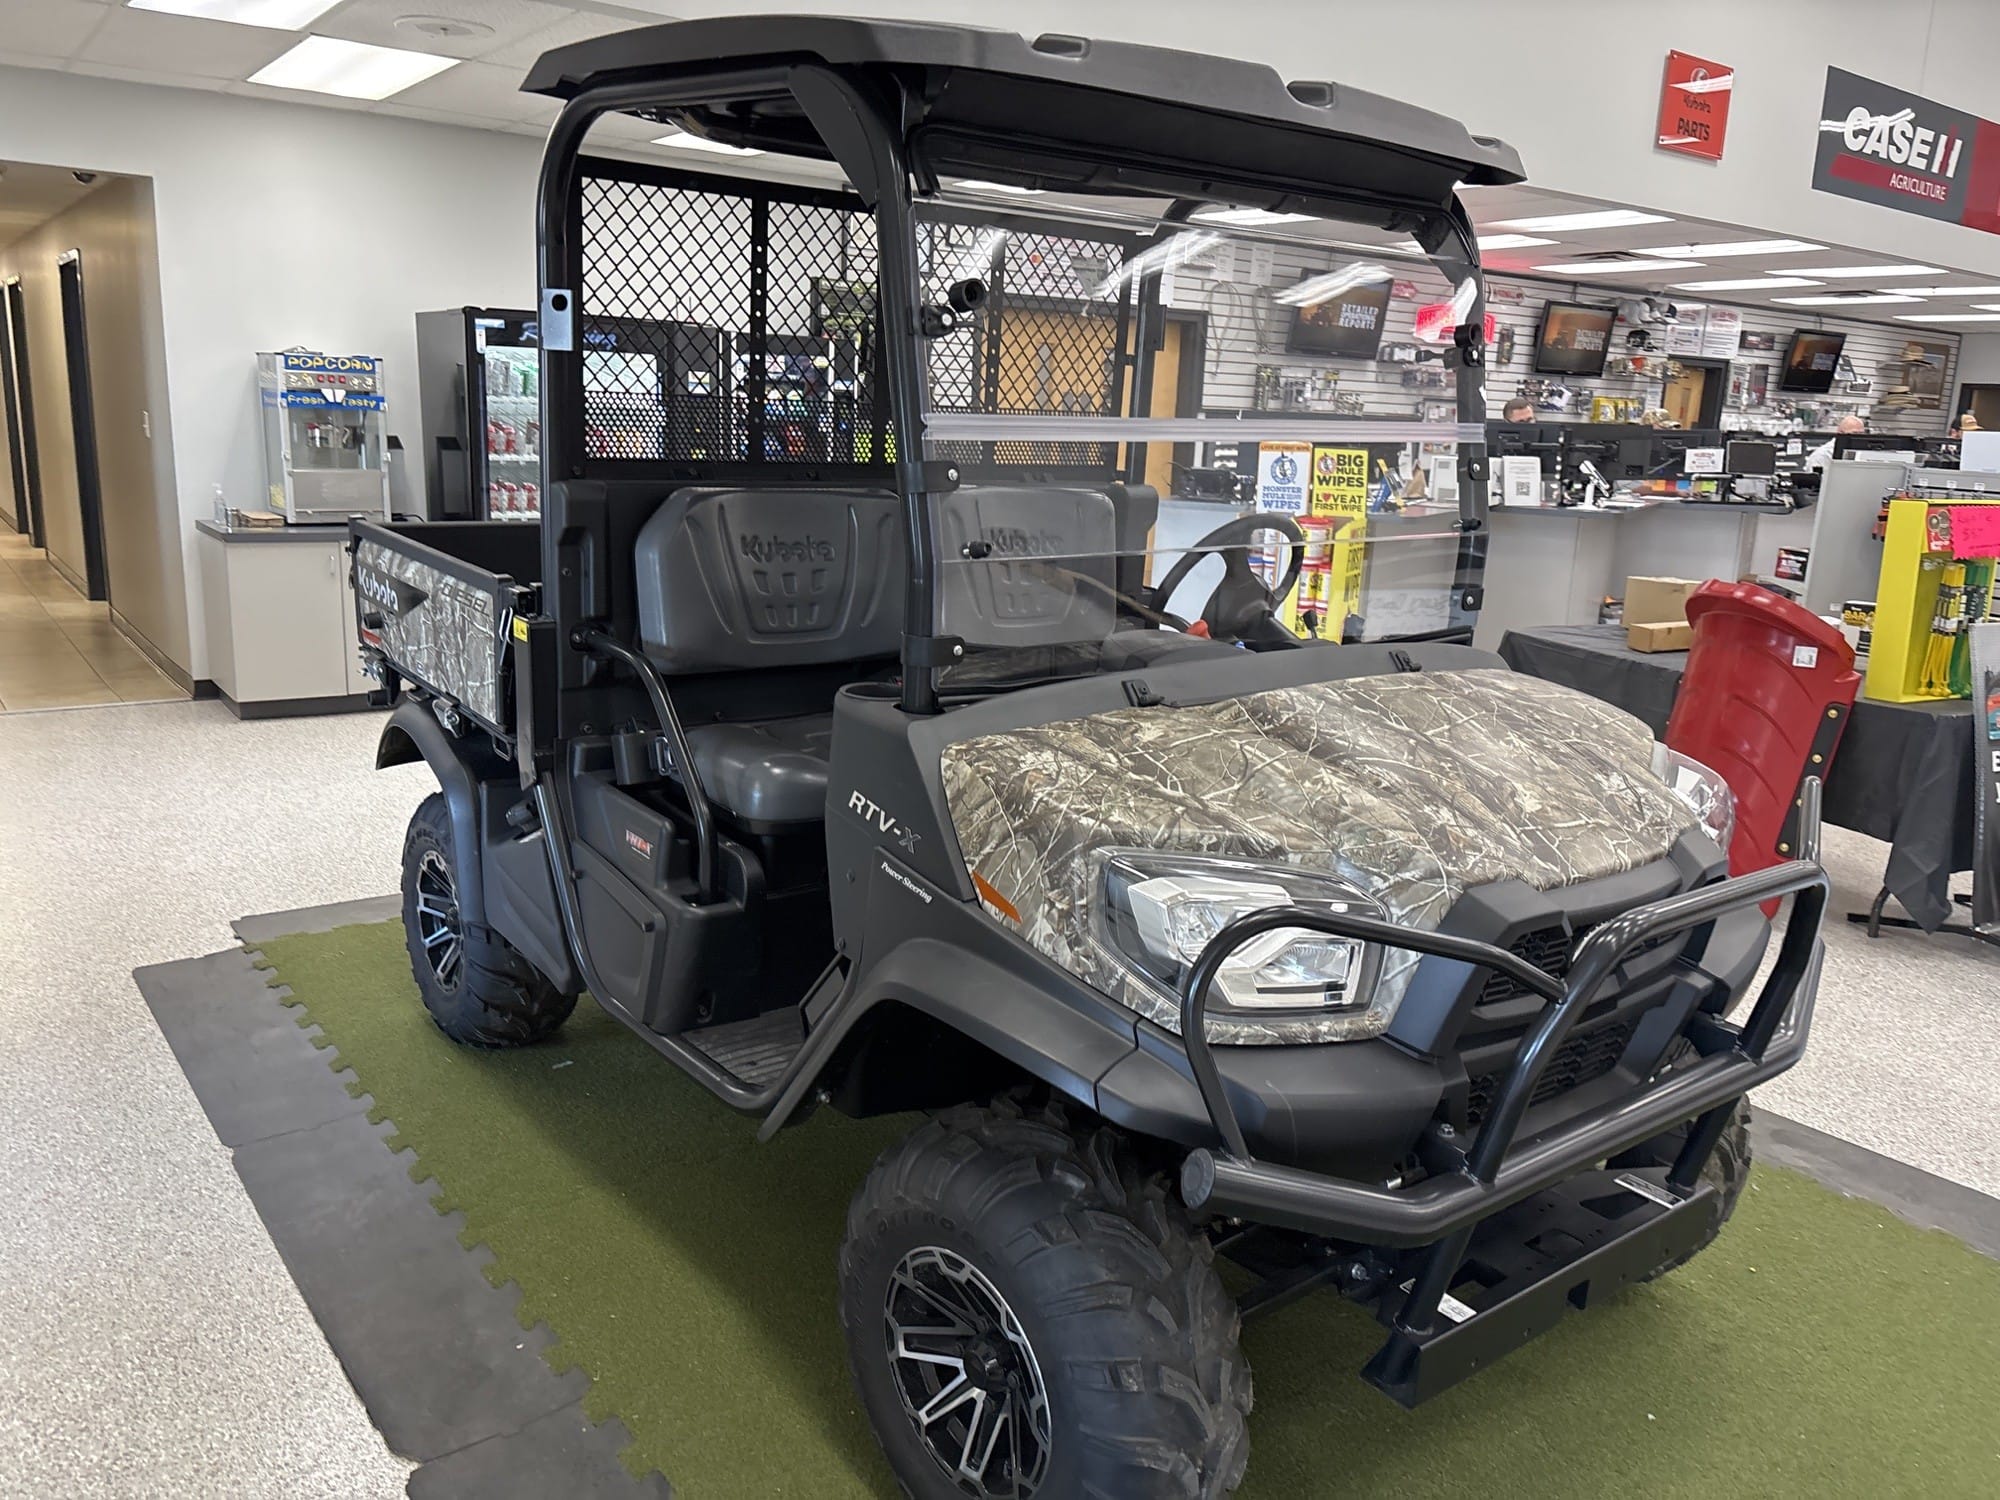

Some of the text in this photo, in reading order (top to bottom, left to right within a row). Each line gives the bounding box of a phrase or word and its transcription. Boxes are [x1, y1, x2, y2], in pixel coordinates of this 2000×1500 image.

[1677, 117, 1710, 141] PARTS
[1889, 172, 1947, 201] AGRICULTURE
[288, 357, 373, 371] POPCORN
[287, 395, 326, 405] Fresh
[1337, 454, 1364, 467] BIG
[1336, 467, 1364, 476] MULE
[1317, 475, 1364, 487] WIPES
[1263, 500, 1301, 510] WIPES
[1348, 495, 1364, 504] AT
[1340, 504, 1363, 512] WIPE
[741, 535, 835, 562] Kubota
[358, 565, 399, 611] Kubota
[848, 790, 921, 854] RTV-X
[881, 861, 933, 904] Power Steering
